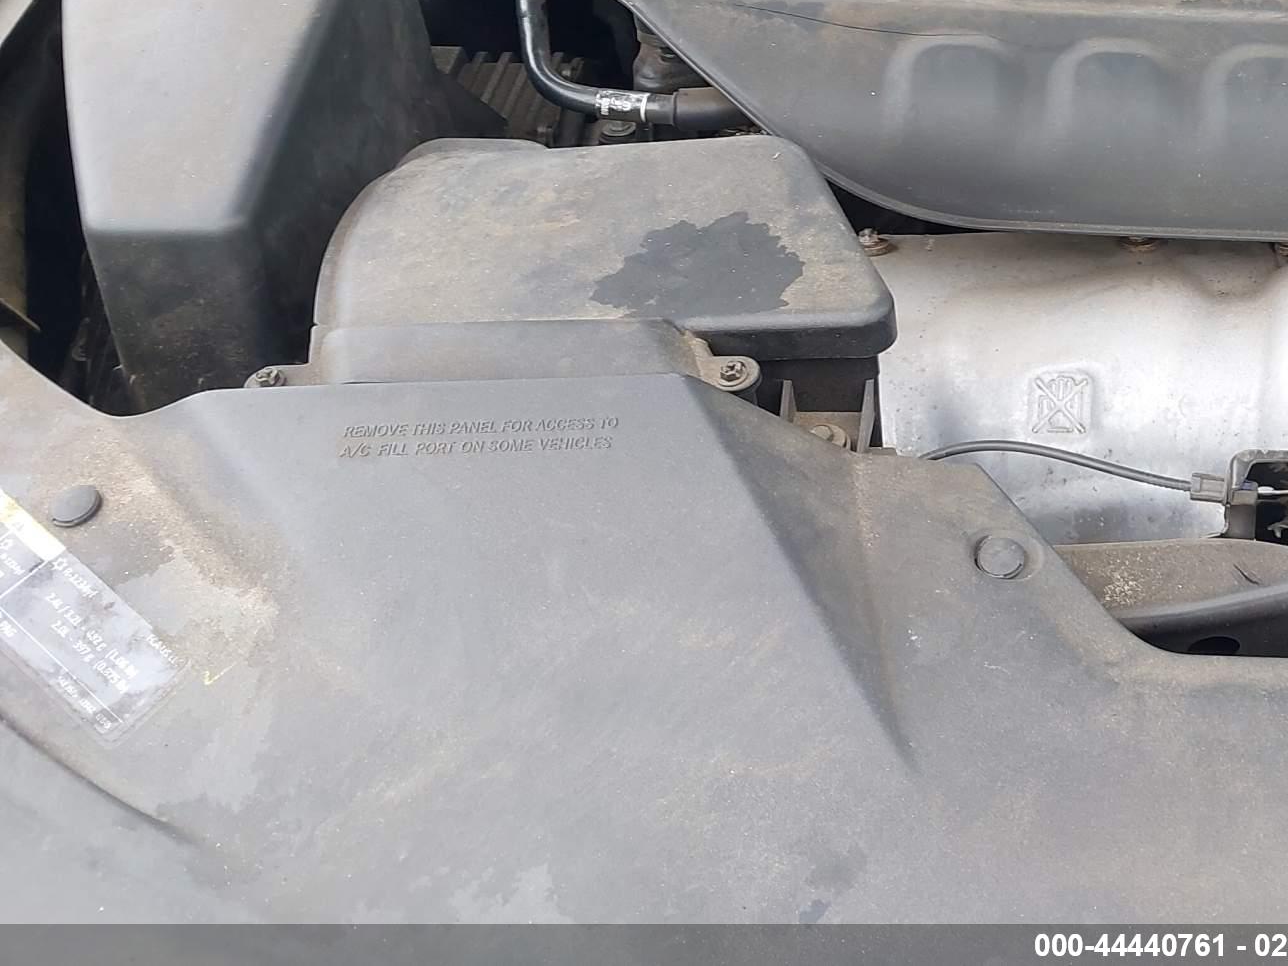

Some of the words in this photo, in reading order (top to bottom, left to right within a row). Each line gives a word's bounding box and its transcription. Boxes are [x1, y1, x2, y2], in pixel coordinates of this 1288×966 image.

[344, 423, 408, 438] REMOVE
[411, 422, 446, 435] THIS
[449, 420, 497, 434] PANEL
[501, 418, 533, 433] FOR
[535, 417, 595, 431] ACCESS
[598, 416, 619, 429] TO
[339, 444, 371, 458] A/C
[376, 442, 408, 456] FILL
[415, 441, 455, 455] PORT
[460, 439, 485, 453] ON
[487, 437, 533, 452] SOME
[538, 436, 613, 450] VEHICLES
